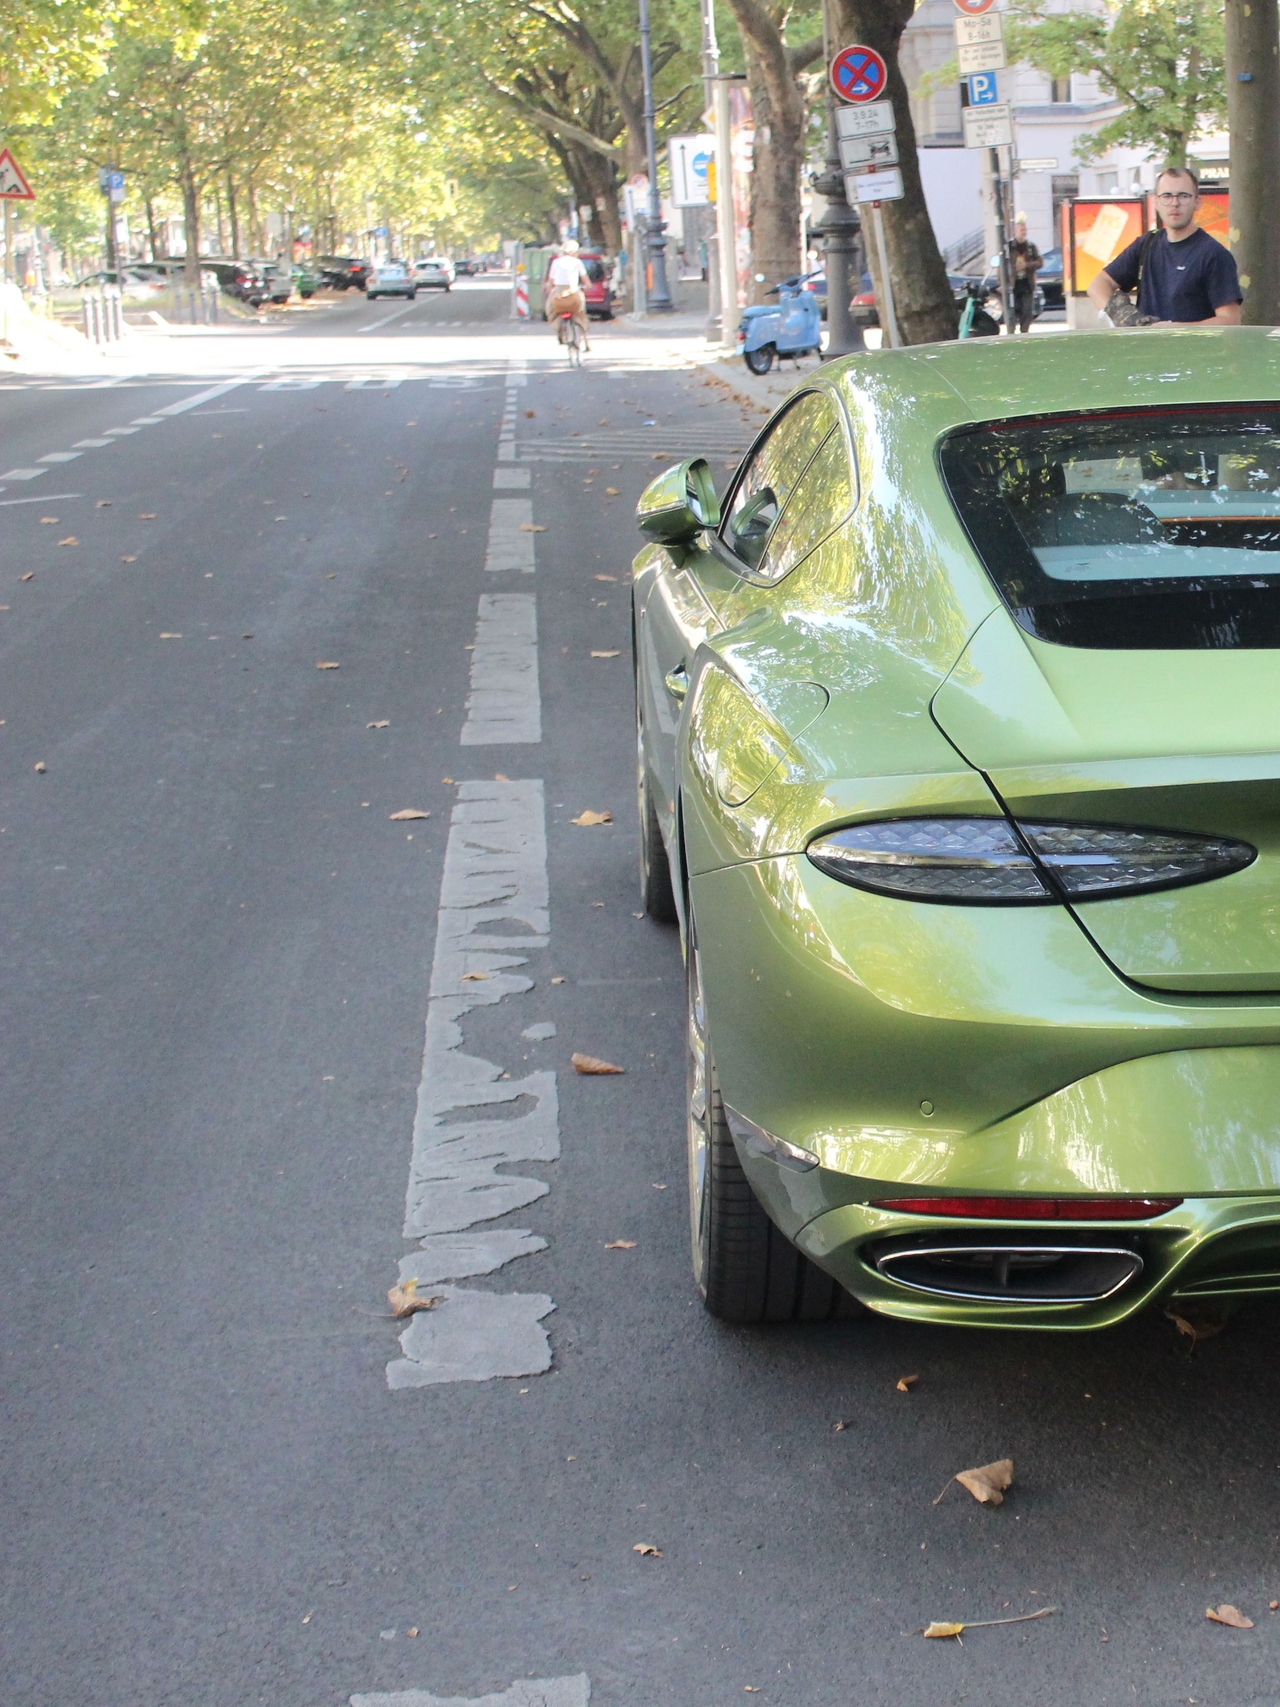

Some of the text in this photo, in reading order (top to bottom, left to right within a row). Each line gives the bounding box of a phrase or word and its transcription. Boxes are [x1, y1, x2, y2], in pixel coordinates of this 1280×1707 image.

[963, 17, 992, 28] Mo-Sa
[972, 75, 989, 102] P
[1199, 166, 1230, 179] PRA
